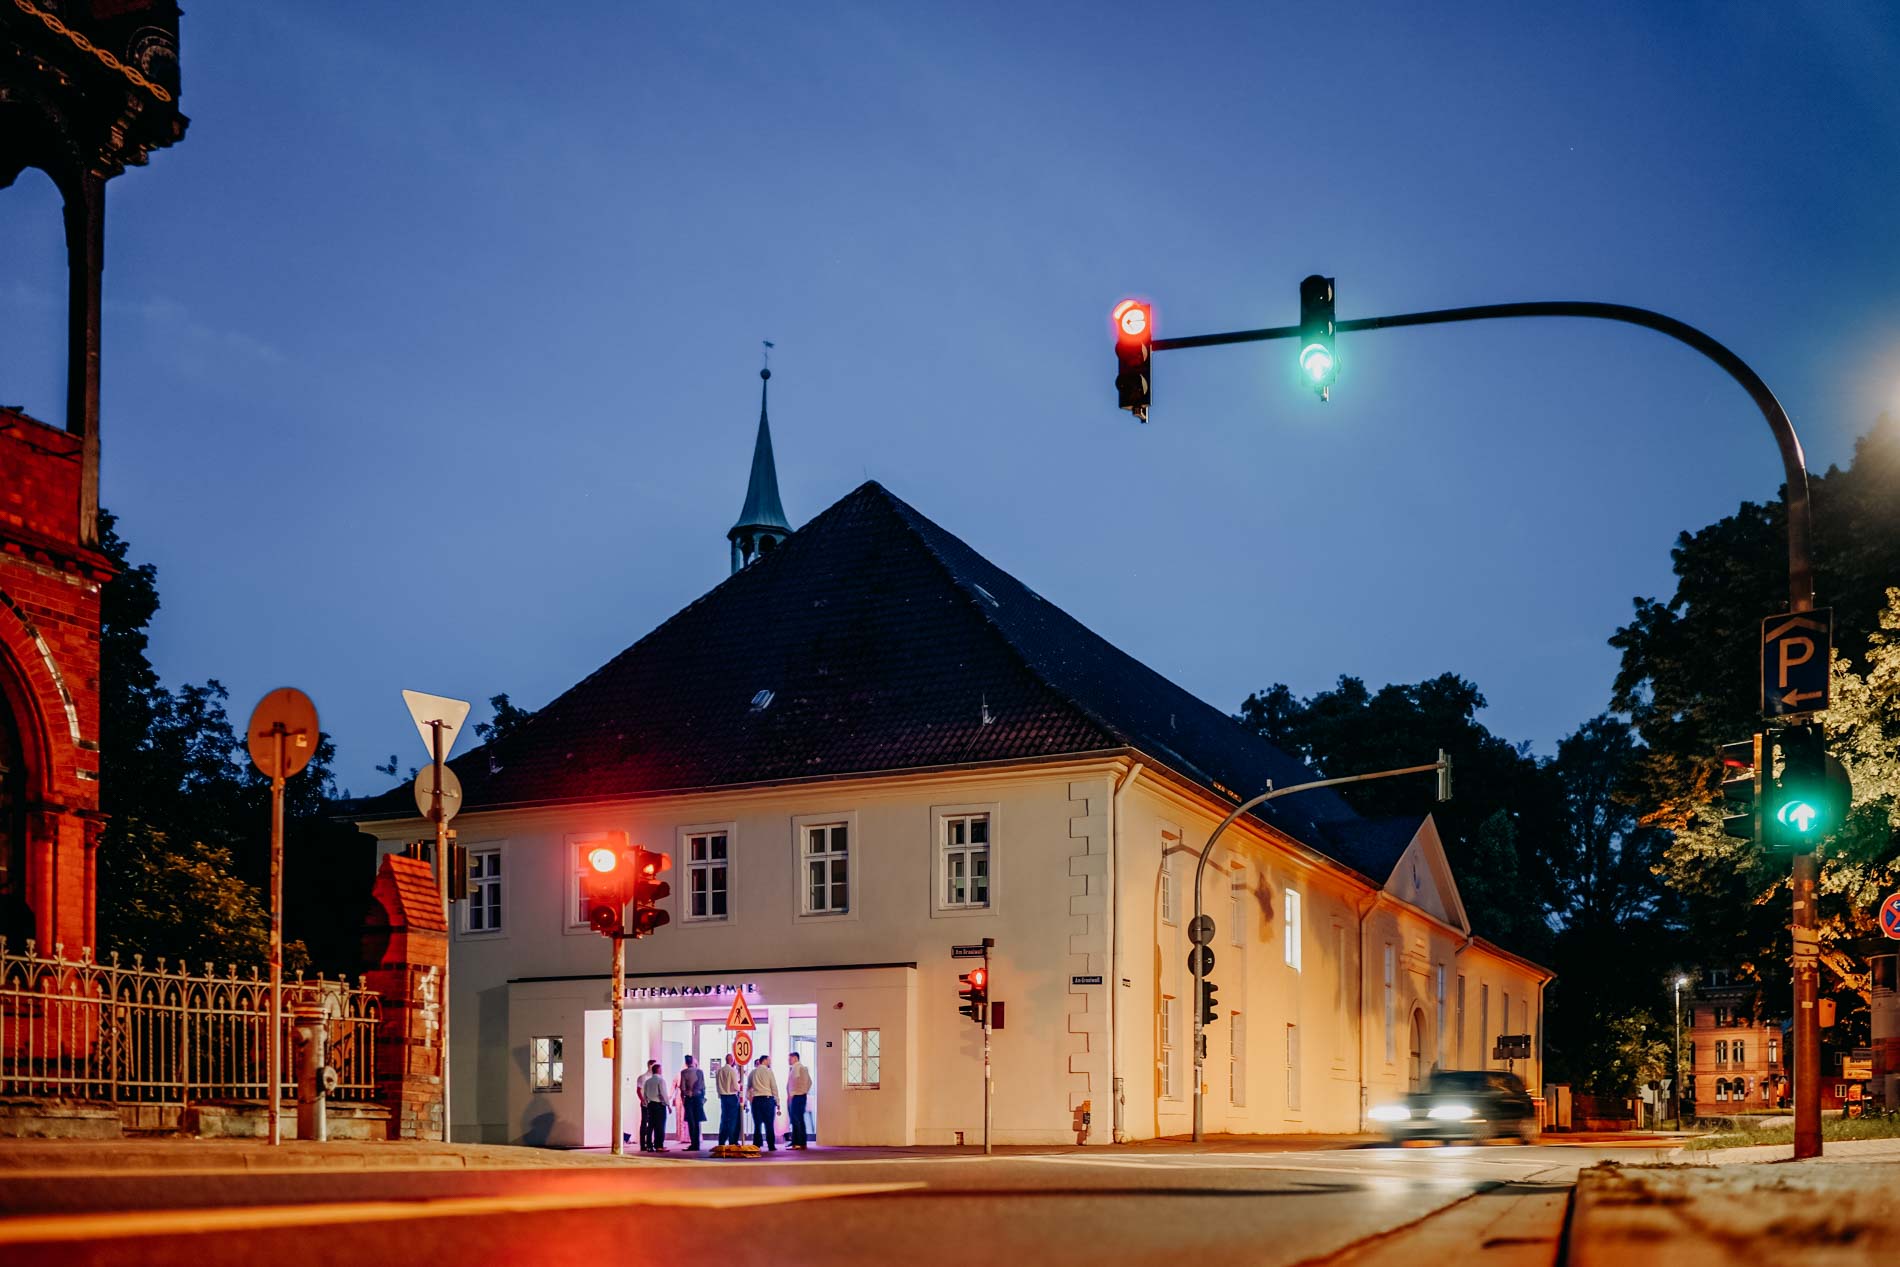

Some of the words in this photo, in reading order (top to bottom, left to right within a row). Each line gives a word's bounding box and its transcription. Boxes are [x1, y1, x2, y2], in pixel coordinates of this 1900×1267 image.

[1779, 637, 1815, 688] P
[623, 983, 756, 998] ITTERAKADEMIE
[737, 1041, 749, 1056] 30
